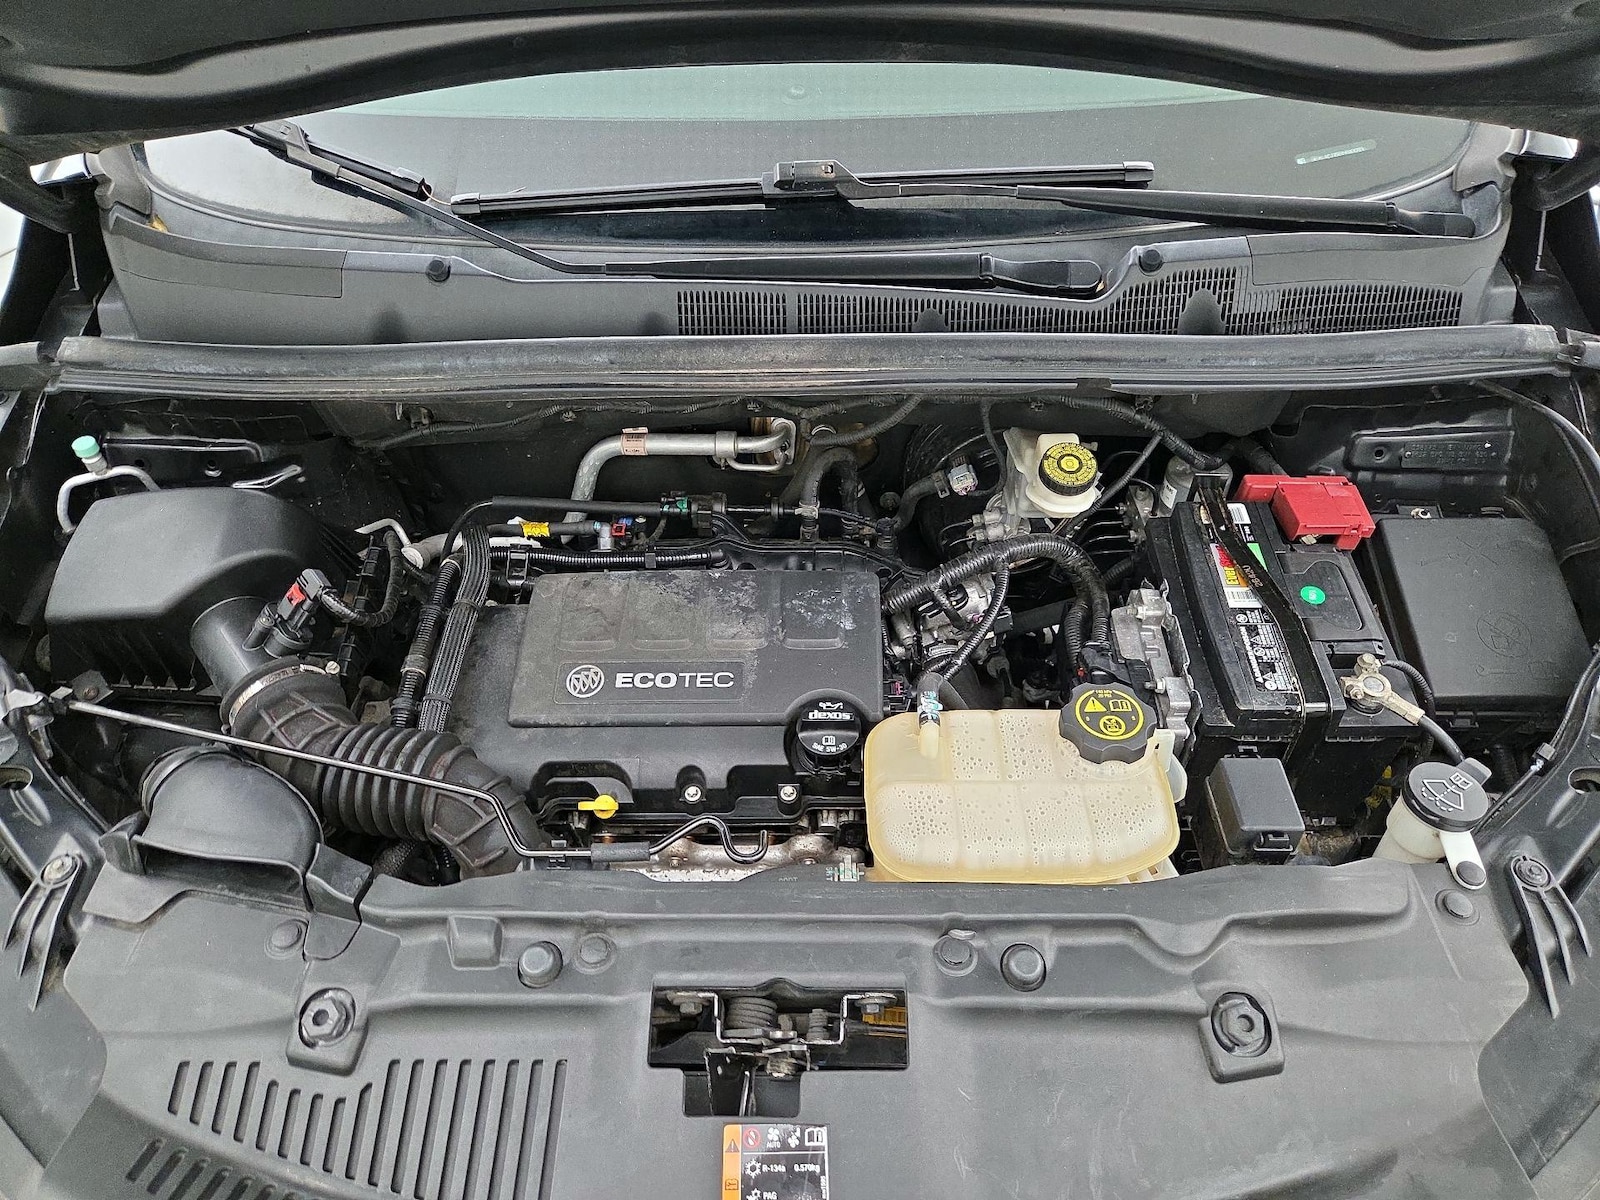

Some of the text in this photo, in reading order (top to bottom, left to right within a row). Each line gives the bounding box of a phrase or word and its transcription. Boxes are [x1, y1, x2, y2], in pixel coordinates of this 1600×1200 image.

[615, 671, 735, 689] ECOTEC
[808, 709, 851, 720] dexos
[811, 742, 848, 753] SAE 5W-30
